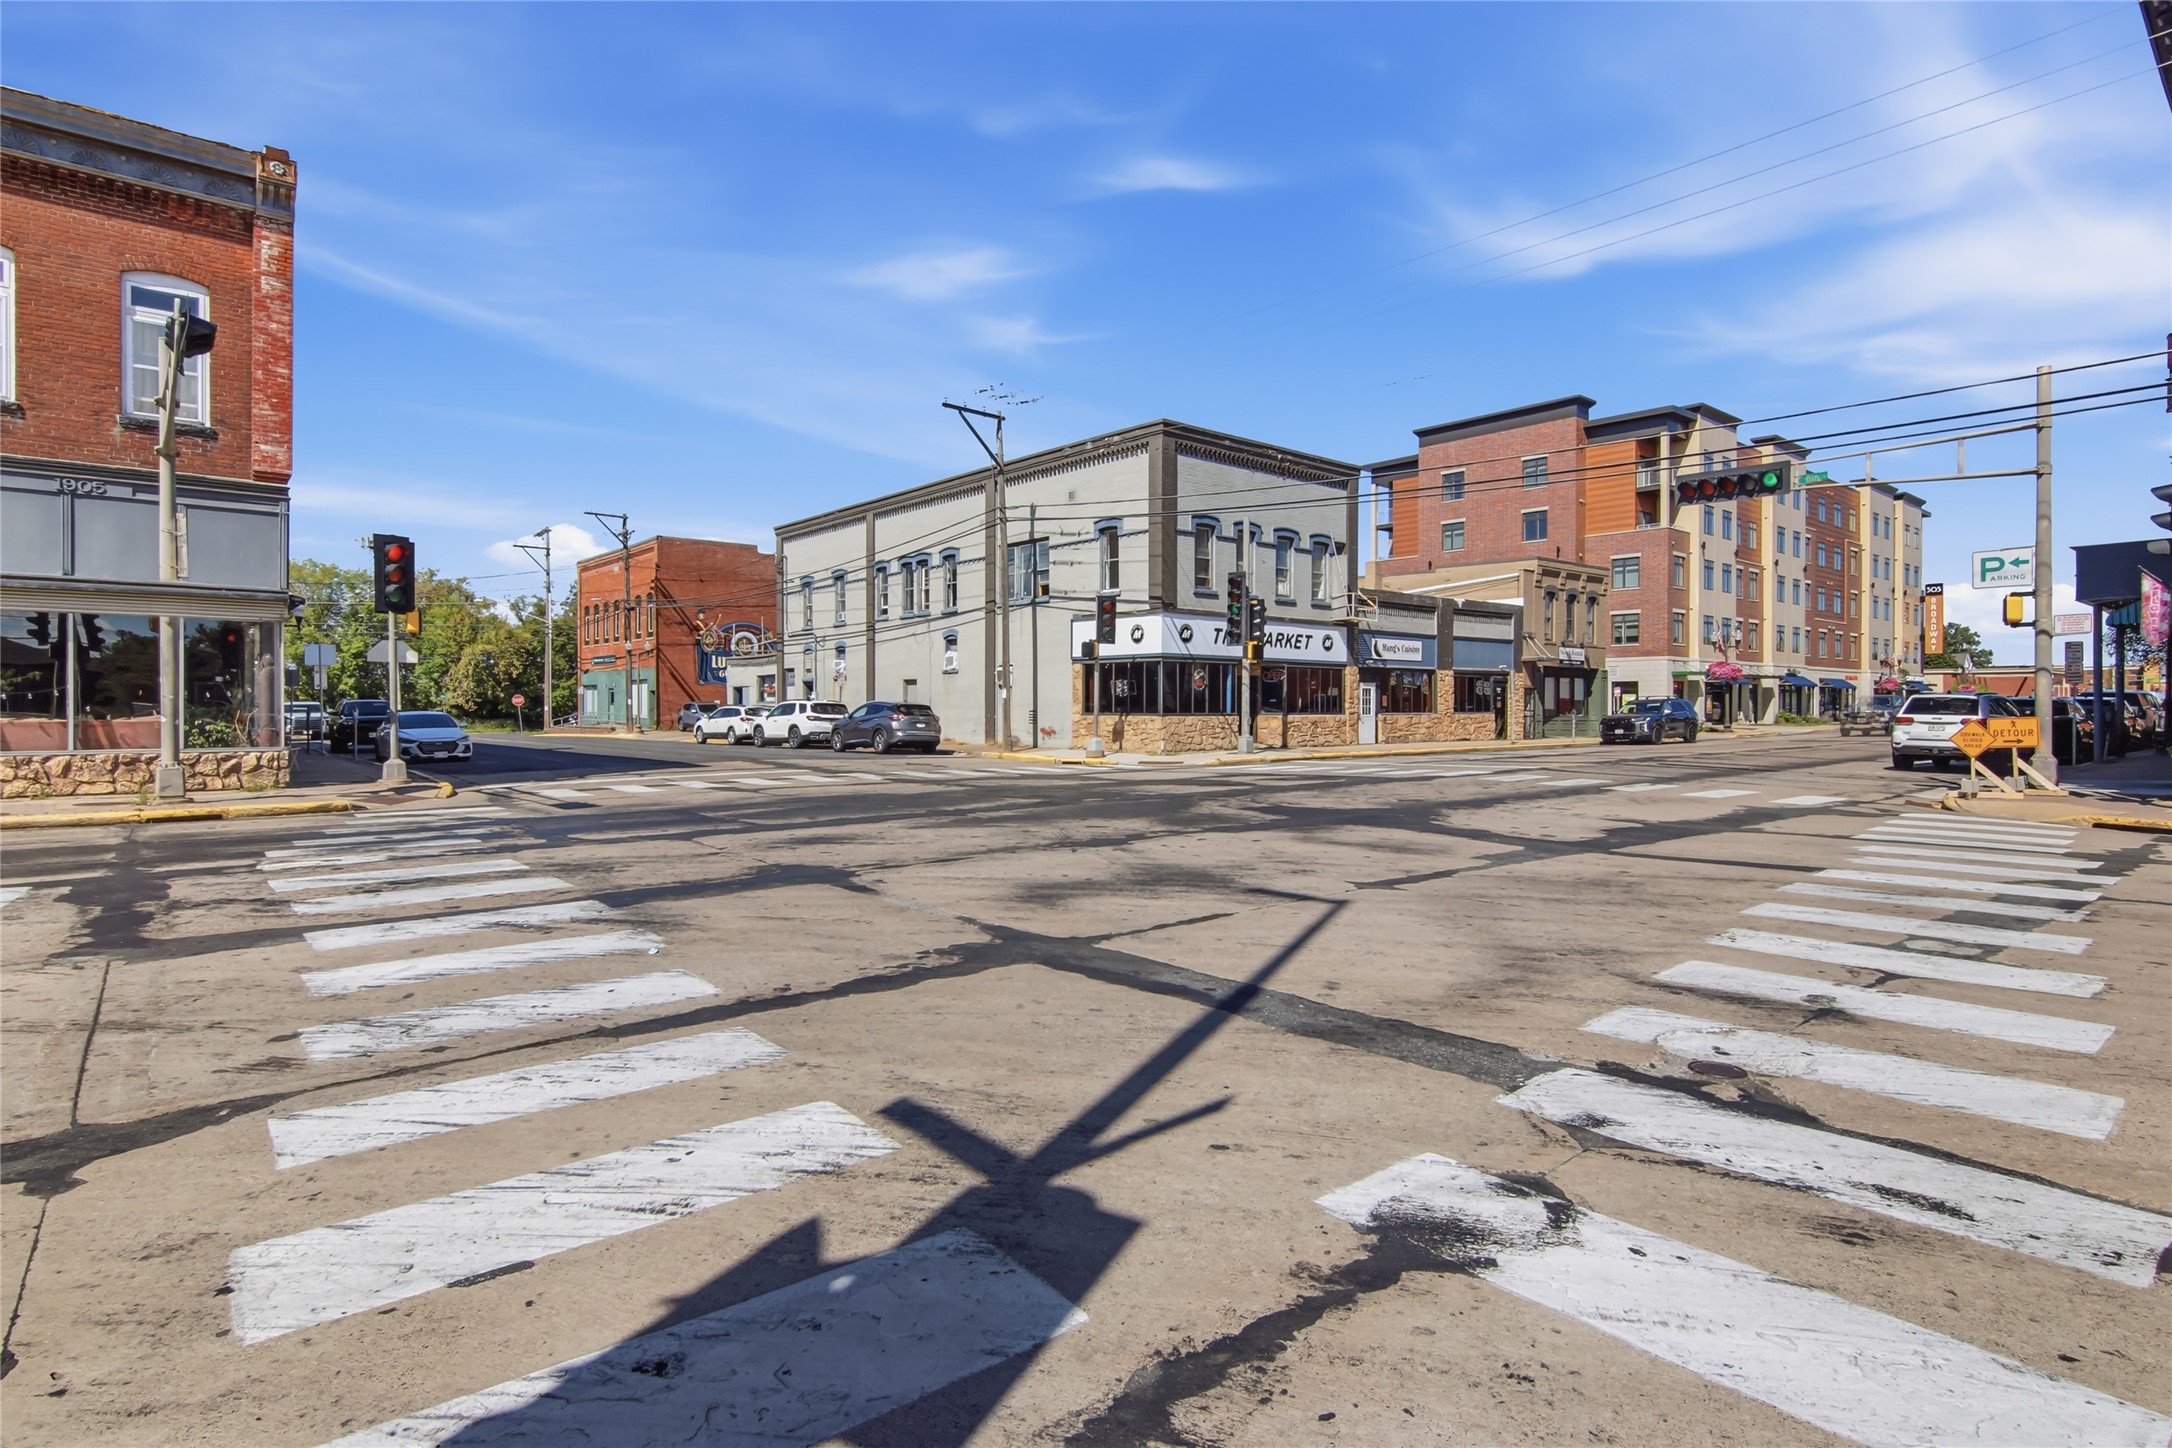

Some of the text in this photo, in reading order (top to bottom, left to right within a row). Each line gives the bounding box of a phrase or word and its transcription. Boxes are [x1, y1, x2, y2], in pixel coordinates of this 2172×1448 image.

[53, 477, 106, 494] 1905
[1929, 597, 1938, 651] BROADWAY
[1263, 632, 1313, 650] ARKET
[1993, 729, 2034, 737] DETOUR
